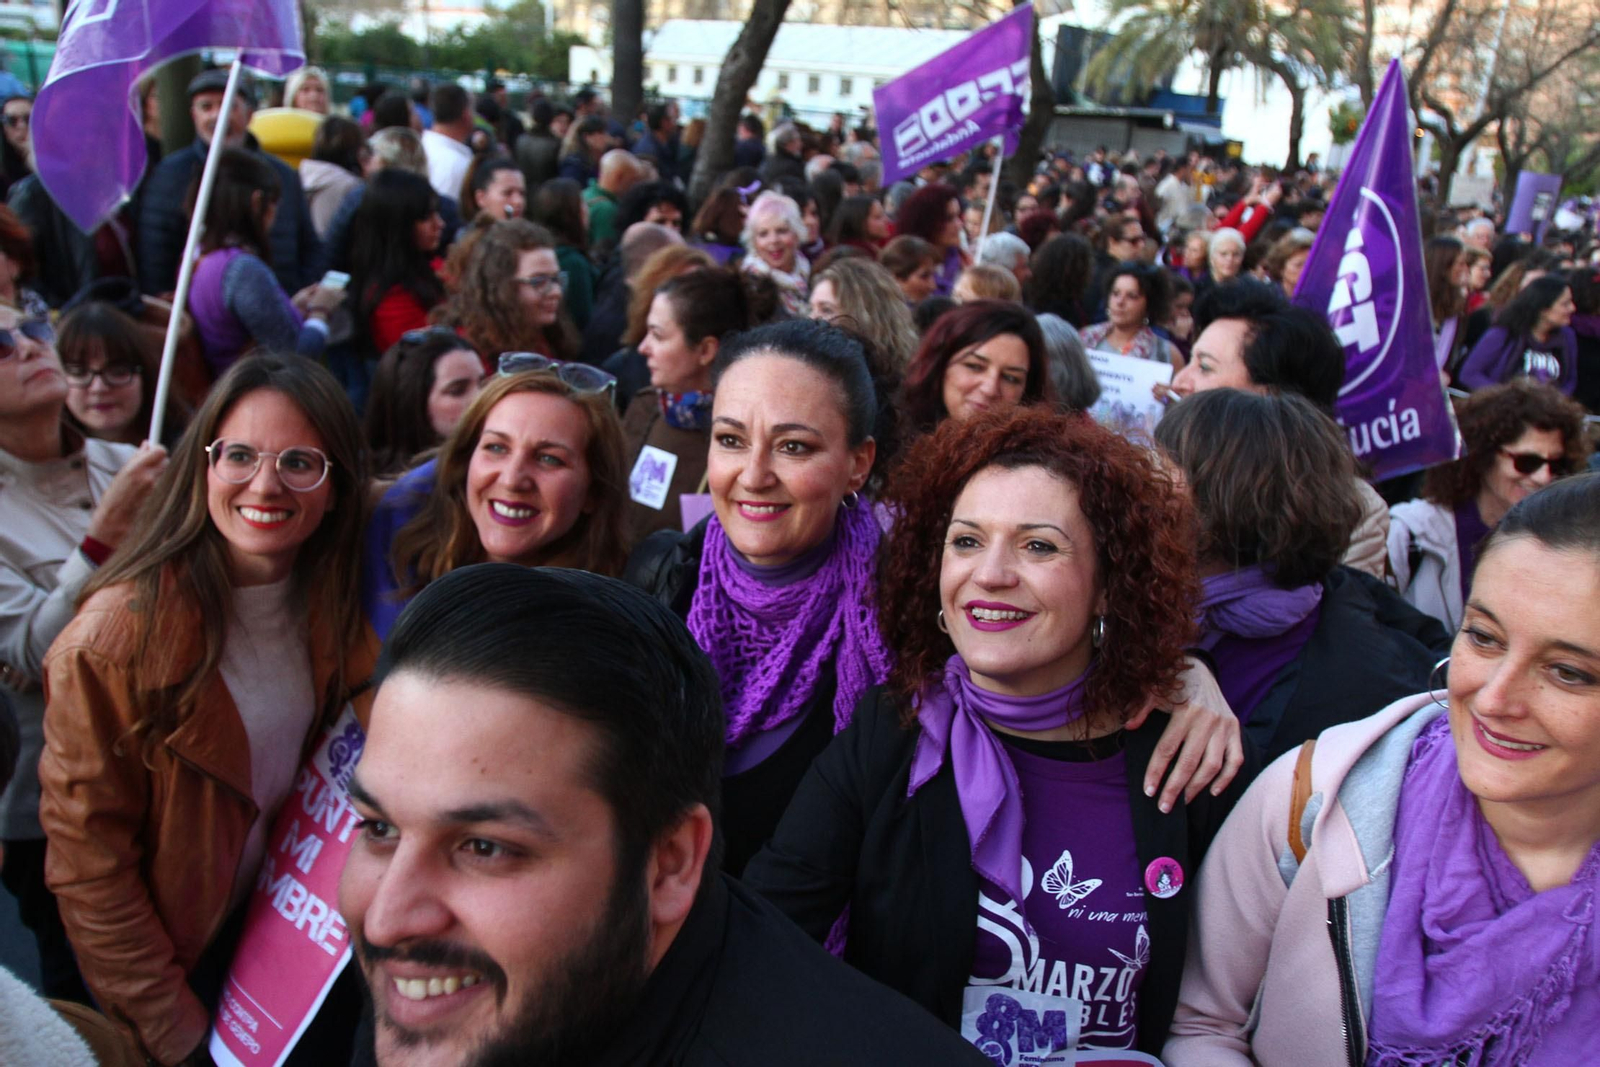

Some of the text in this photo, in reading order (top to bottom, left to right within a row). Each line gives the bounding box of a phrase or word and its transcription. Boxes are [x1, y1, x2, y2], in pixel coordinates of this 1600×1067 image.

[1336, 398, 1421, 457] ucía
[281, 820, 323, 874] MI
[1068, 904, 1149, 923] ni una men
[1012, 957, 1137, 1003] MARZO
